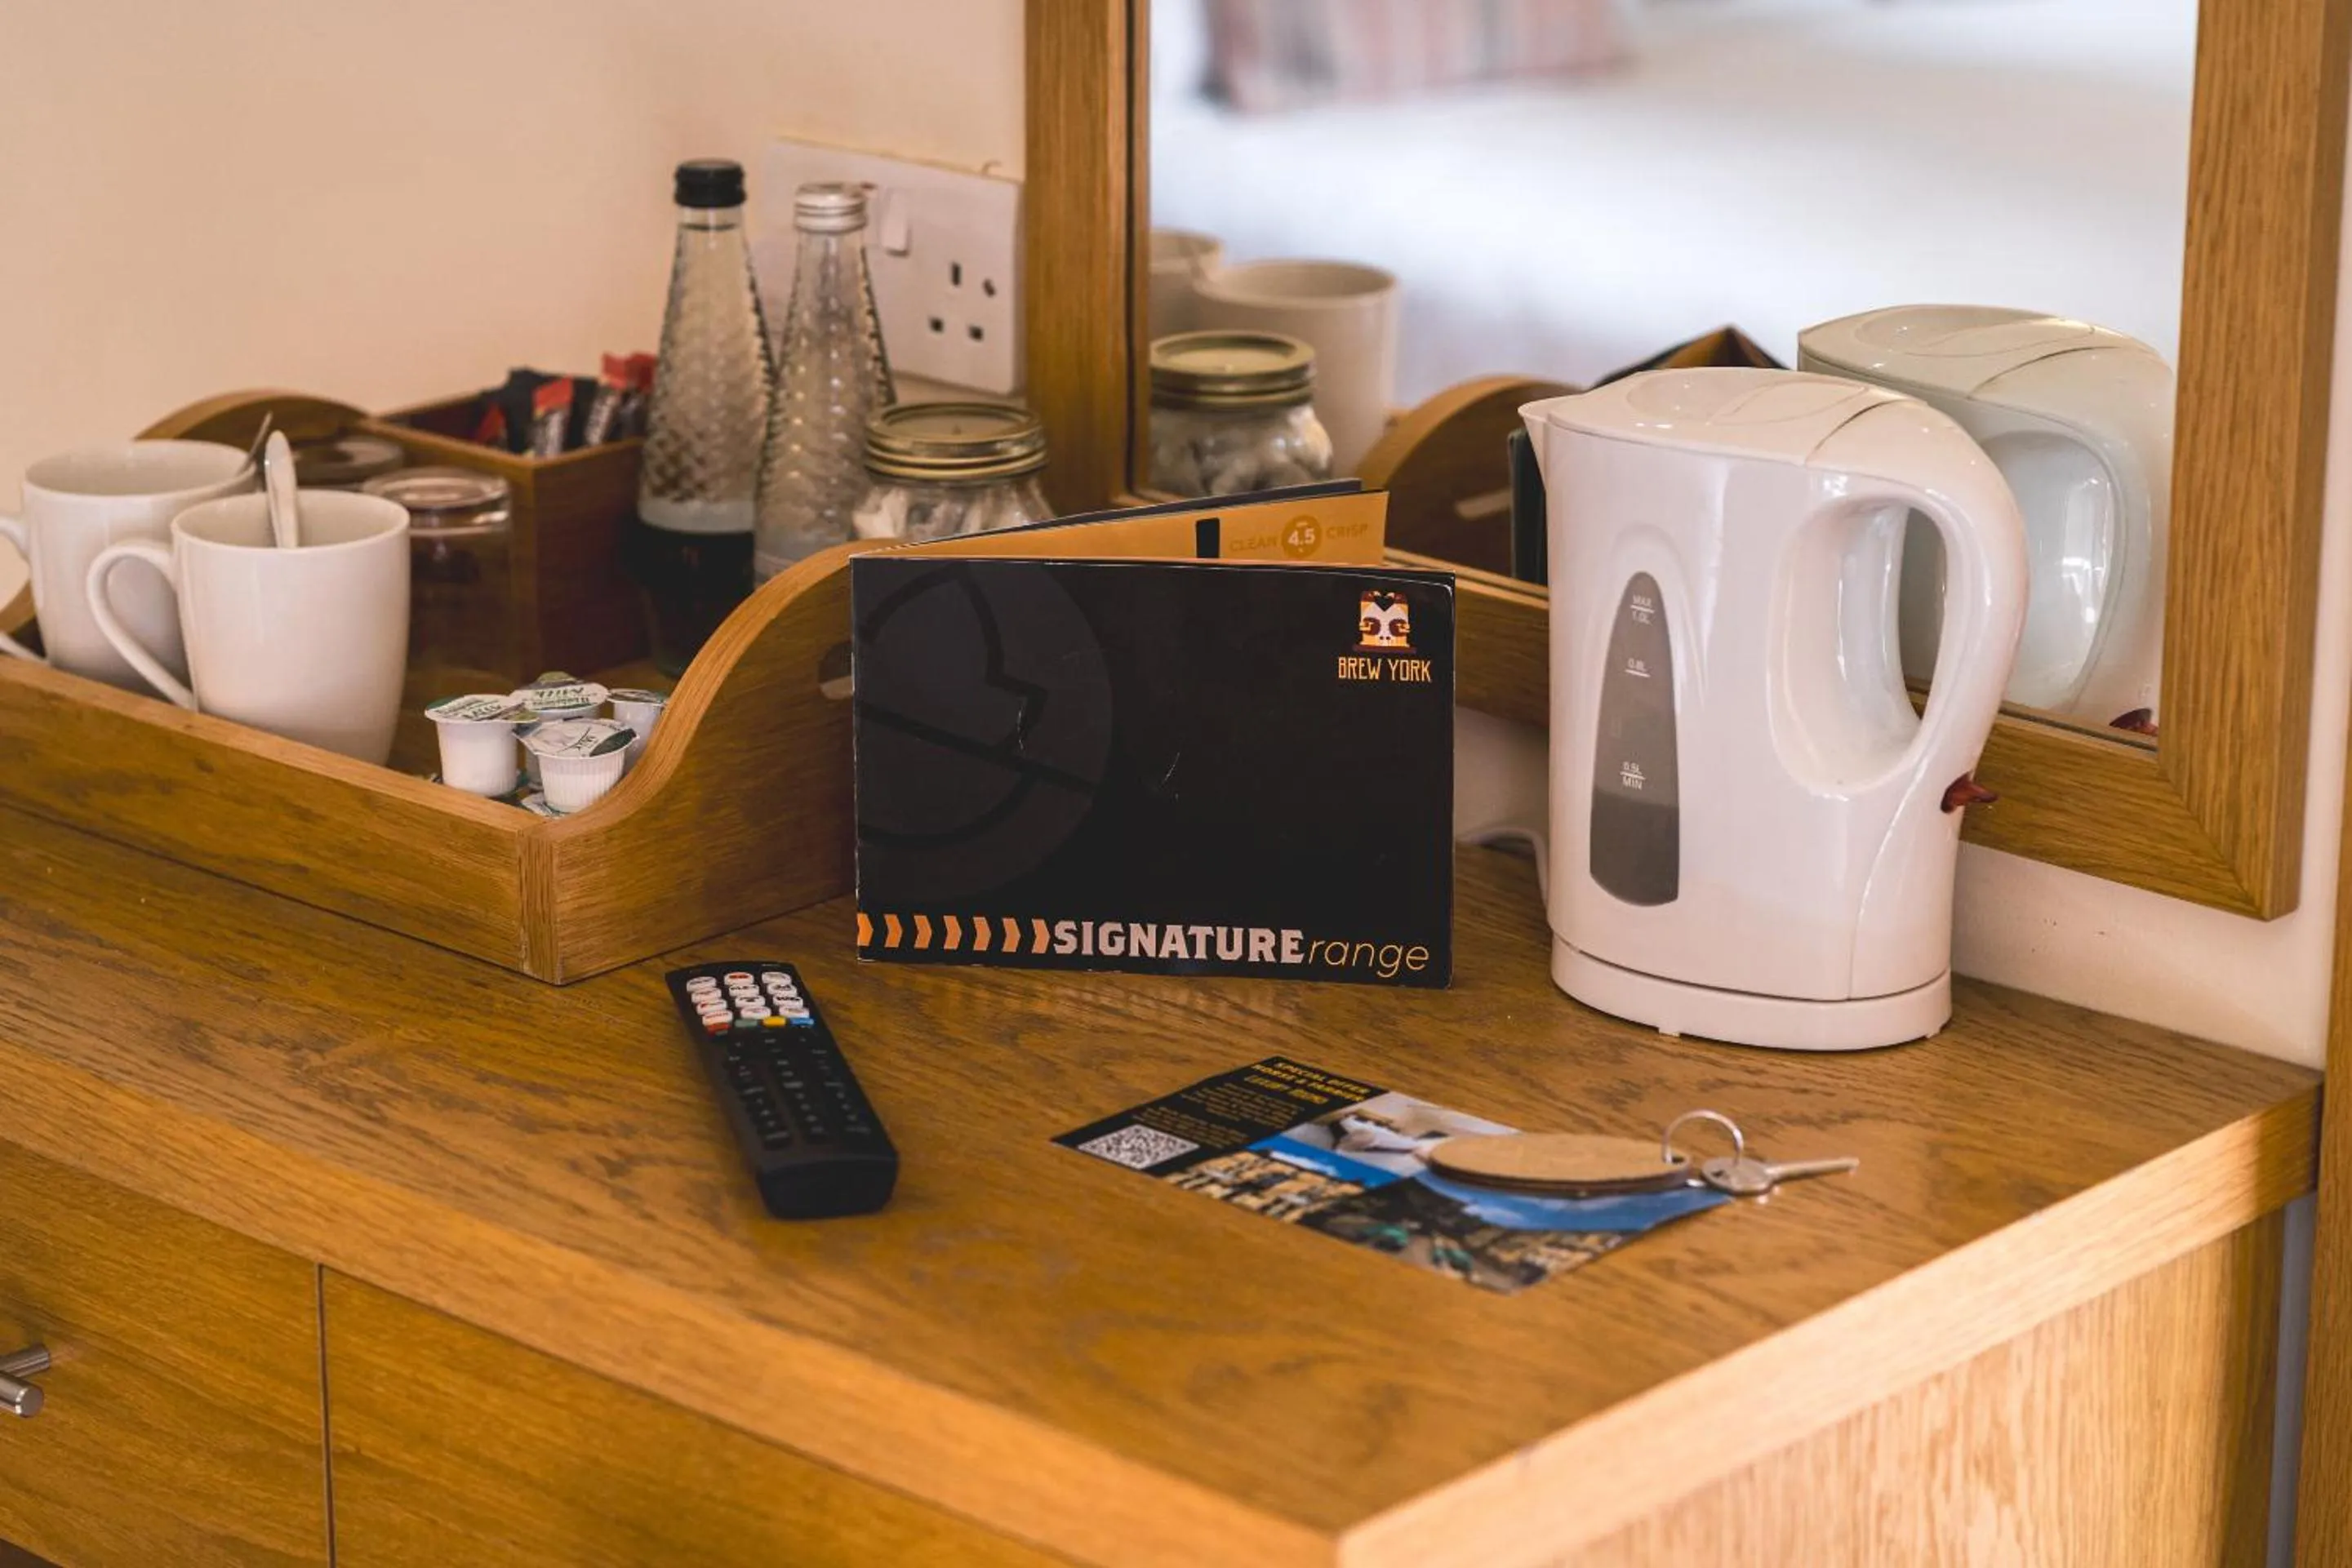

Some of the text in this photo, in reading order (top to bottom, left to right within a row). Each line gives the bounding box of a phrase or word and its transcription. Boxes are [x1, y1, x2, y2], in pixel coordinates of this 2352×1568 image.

[1230, 522, 1368, 552] CLEAN 4.5 CRISP
[1338, 656, 1433, 683] BREW YORK
[1622, 775, 1643, 790] MIN
[1053, 920, 1429, 978] SIGNATURE range
